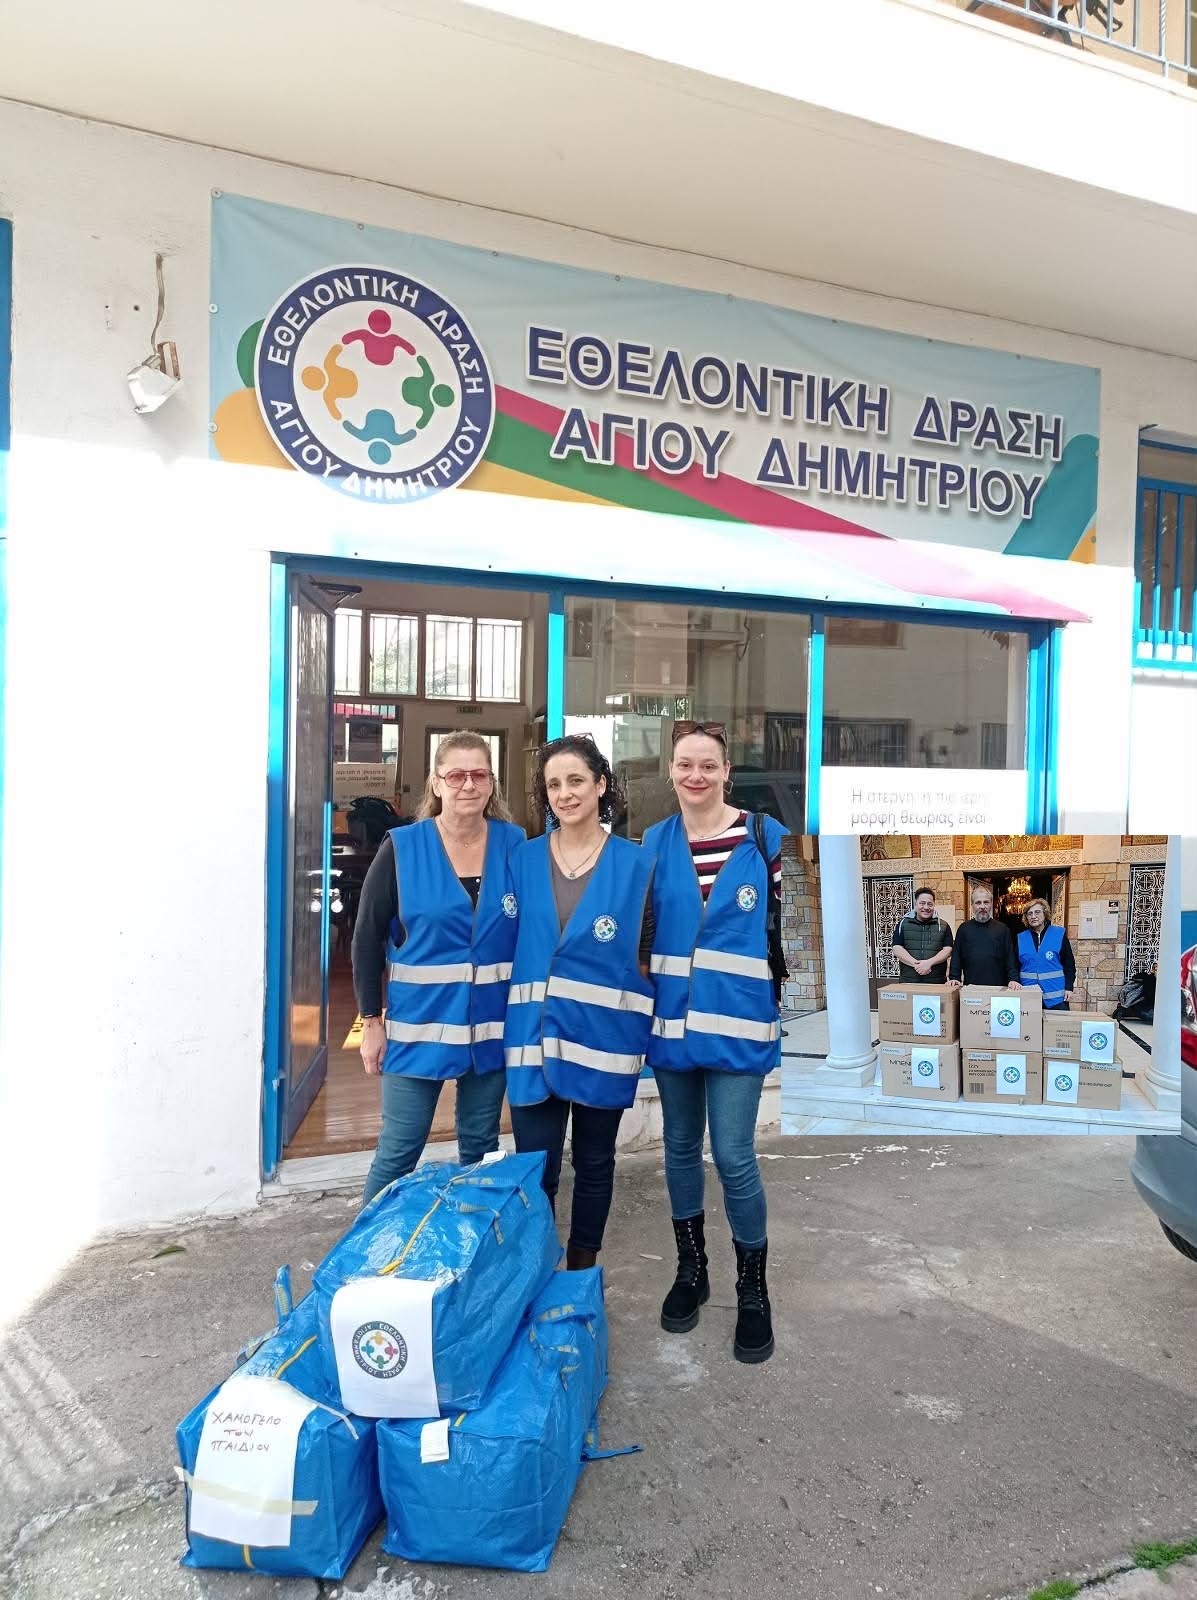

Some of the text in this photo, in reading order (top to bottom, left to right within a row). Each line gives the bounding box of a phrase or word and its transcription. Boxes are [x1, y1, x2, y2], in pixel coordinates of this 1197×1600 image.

[268, 274, 485, 394] ΕΘΕΛΟΝΤΙΚΗ ΔΡΑΣΗ
[527, 325, 1063, 460] ΕΘΕΛΟΝΤΙΚΗ ΔΡΑΣΗ
[269, 399, 483, 499] ΑΓΙΟΥ ΔΗΜΗΤΡΙΟΥ
[550, 407, 1042, 518] ΑΓΙΟΥ ΔΗΜΗΤΡΙΟΥ
[210, 1440, 270, 1452] ΠΑΙΔΙΟΥ
[211, 1411, 282, 1426] ΧΑΜΟΓΕΛΟ
